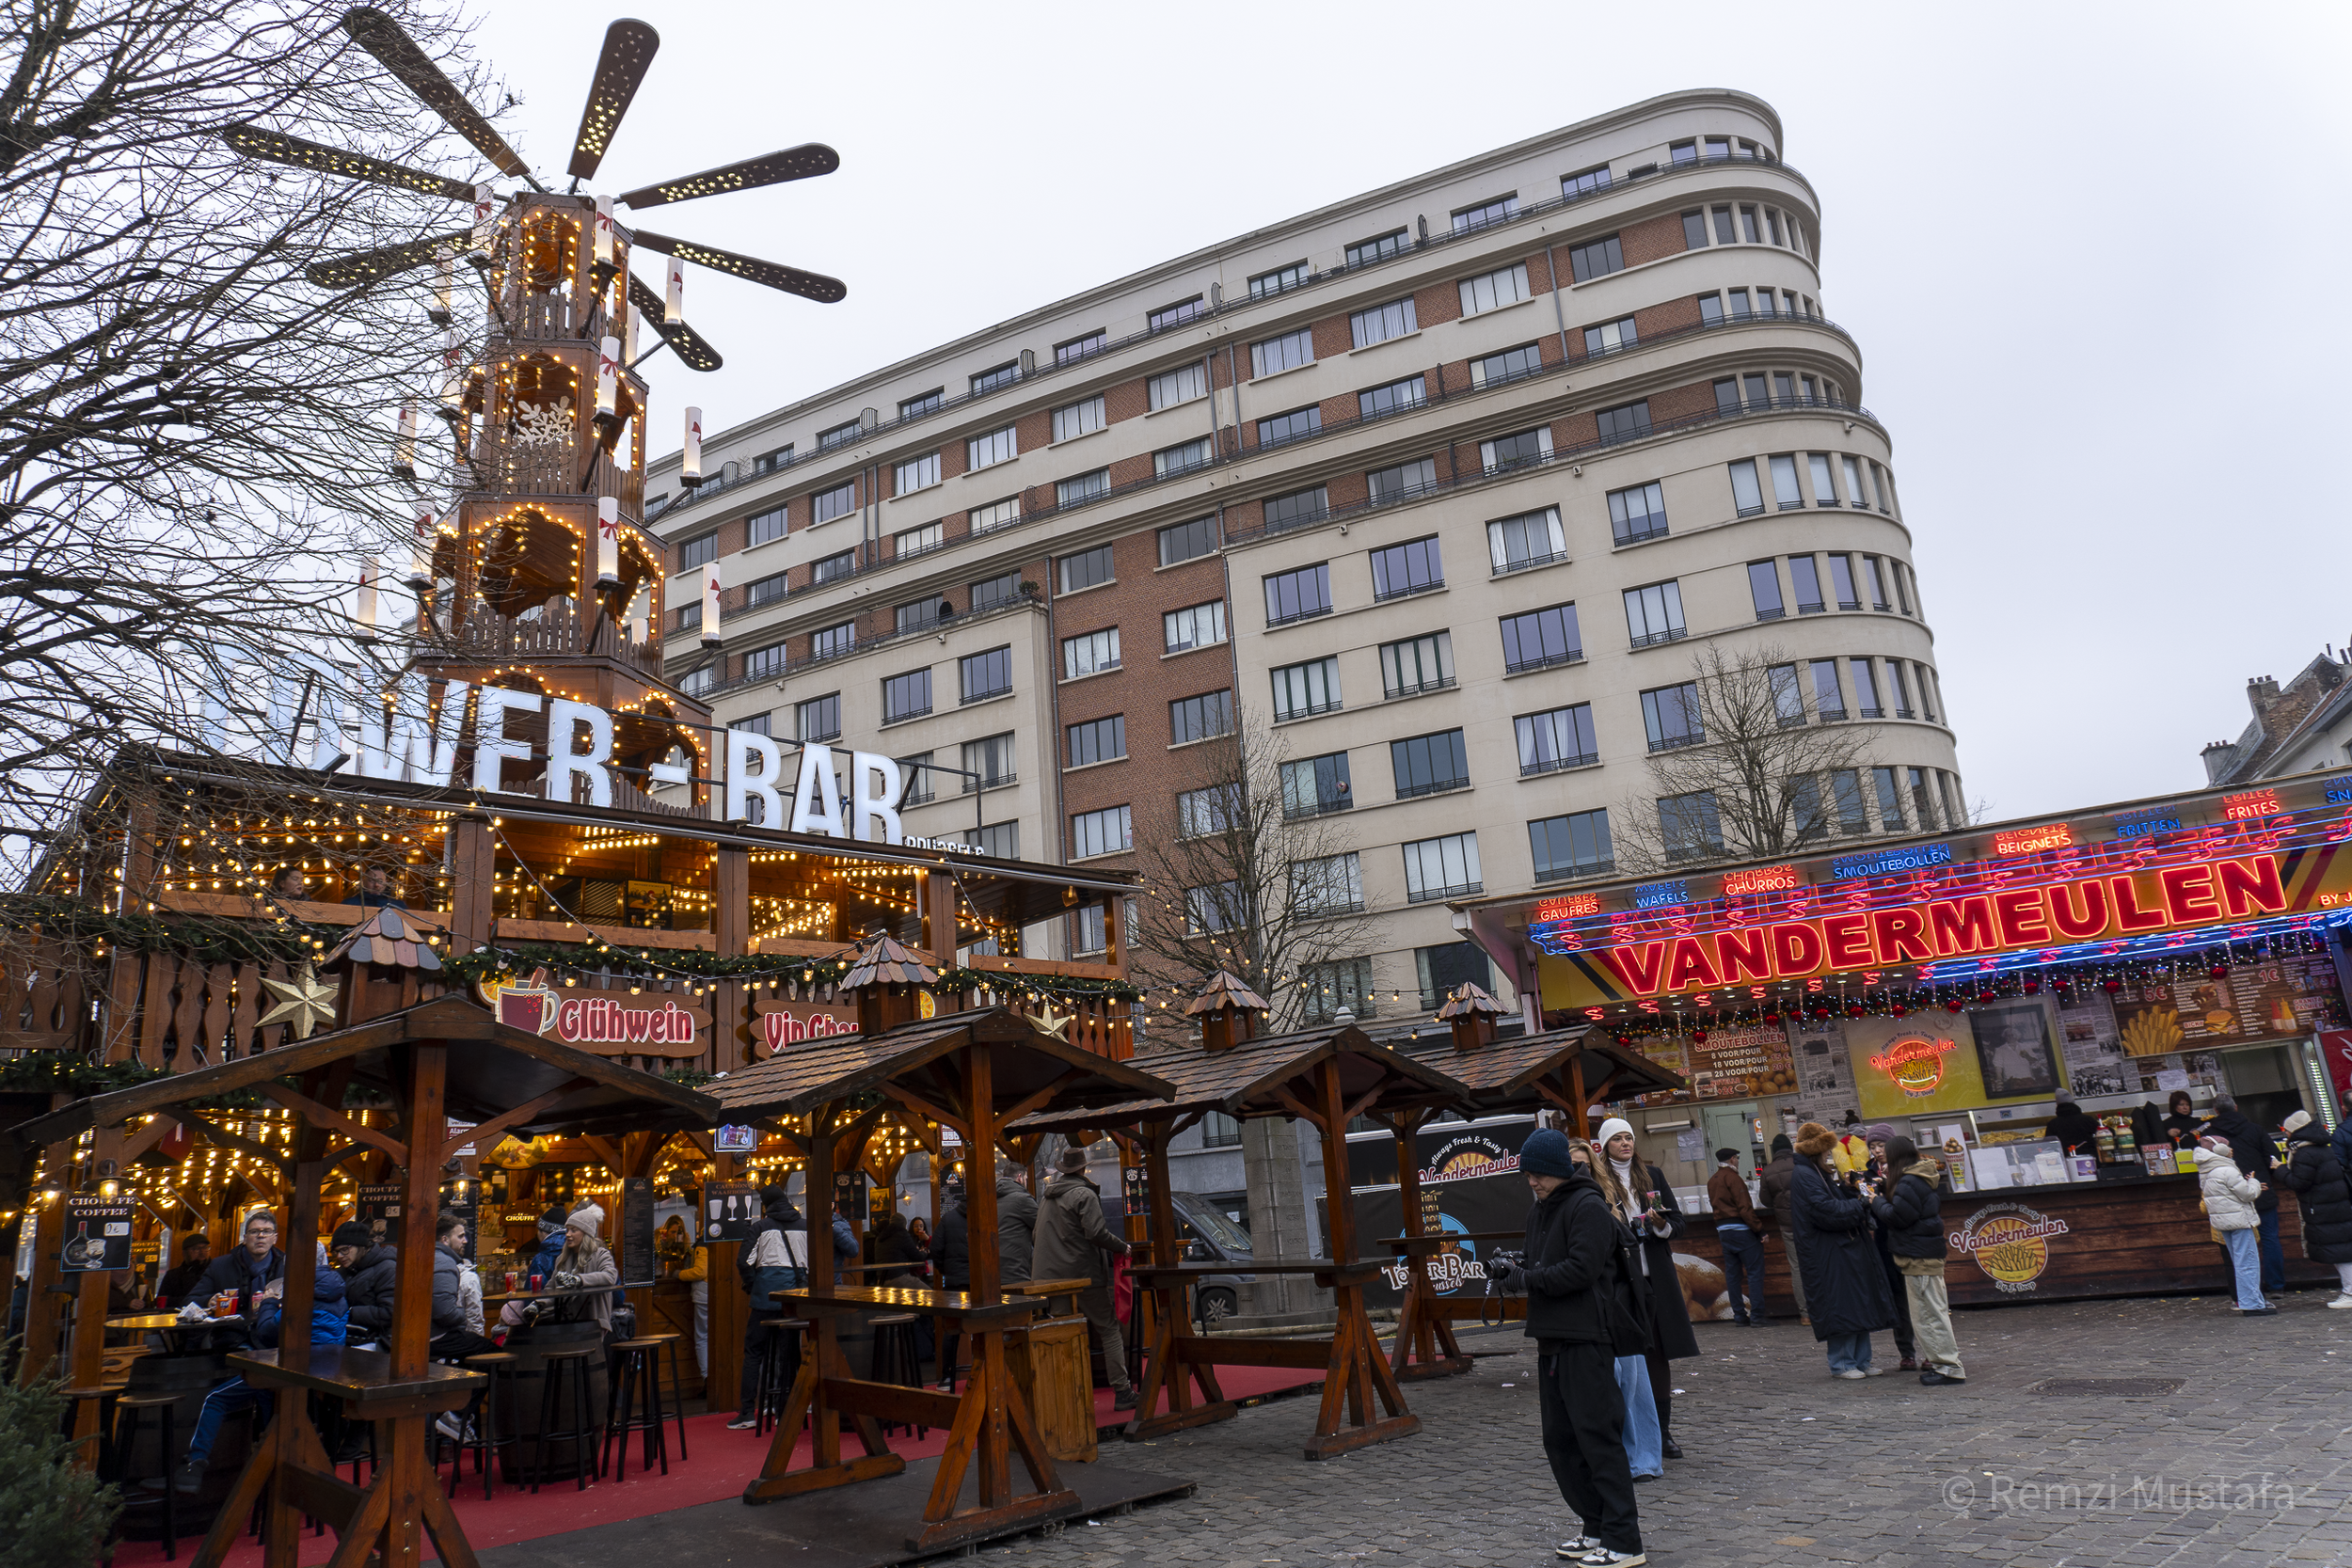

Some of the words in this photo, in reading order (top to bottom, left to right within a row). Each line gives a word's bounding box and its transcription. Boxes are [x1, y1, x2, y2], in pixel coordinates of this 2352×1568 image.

[726, 728, 903, 846] BAR
[2226, 800, 2280, 821] FRITES
[2117, 817, 2182, 839] FRITTEN
[1997, 832, 2073, 855] BEIGNETS
[1834, 848, 1952, 880] SMOUTEBOLLEN
[1725, 876, 1796, 895] CHURROS
[1636, 891, 1690, 909] WAFELS
[2319, 894, 2339, 907] BY
[1539, 901, 1600, 923] GAUFRES
[1613, 854, 2288, 997] VANDERMEULEN
[2144, 985, 2168, 1002] 5€
[557, 997, 695, 1044] Glühwein
[764, 1011, 807, 1053] Vin
[1694, 1033, 1787, 1053] SMOUTEBOLLEN
[1869, 1037, 1958, 1070] Vandermeulen
[1710, 1052, 1717, 1060] 8
[1712, 1060, 1723, 1069] 18
[1770, 1052, 1782, 1061] 15
[1714, 1069, 1724, 1079] 28
[1772, 1062, 1785, 1071] 20
[1431, 1142, 1453, 1165] Always
[1452, 1135, 1473, 1147] Fresh
[1473, 1135, 1481, 1144] &
[1482, 1137, 1502, 1153] Tasty
[73, 1208, 128, 1217] COFFEE
[1986, 1202, 2010, 1213] Fresh
[1949, 1214, 2069, 1254] Vandermeulen
